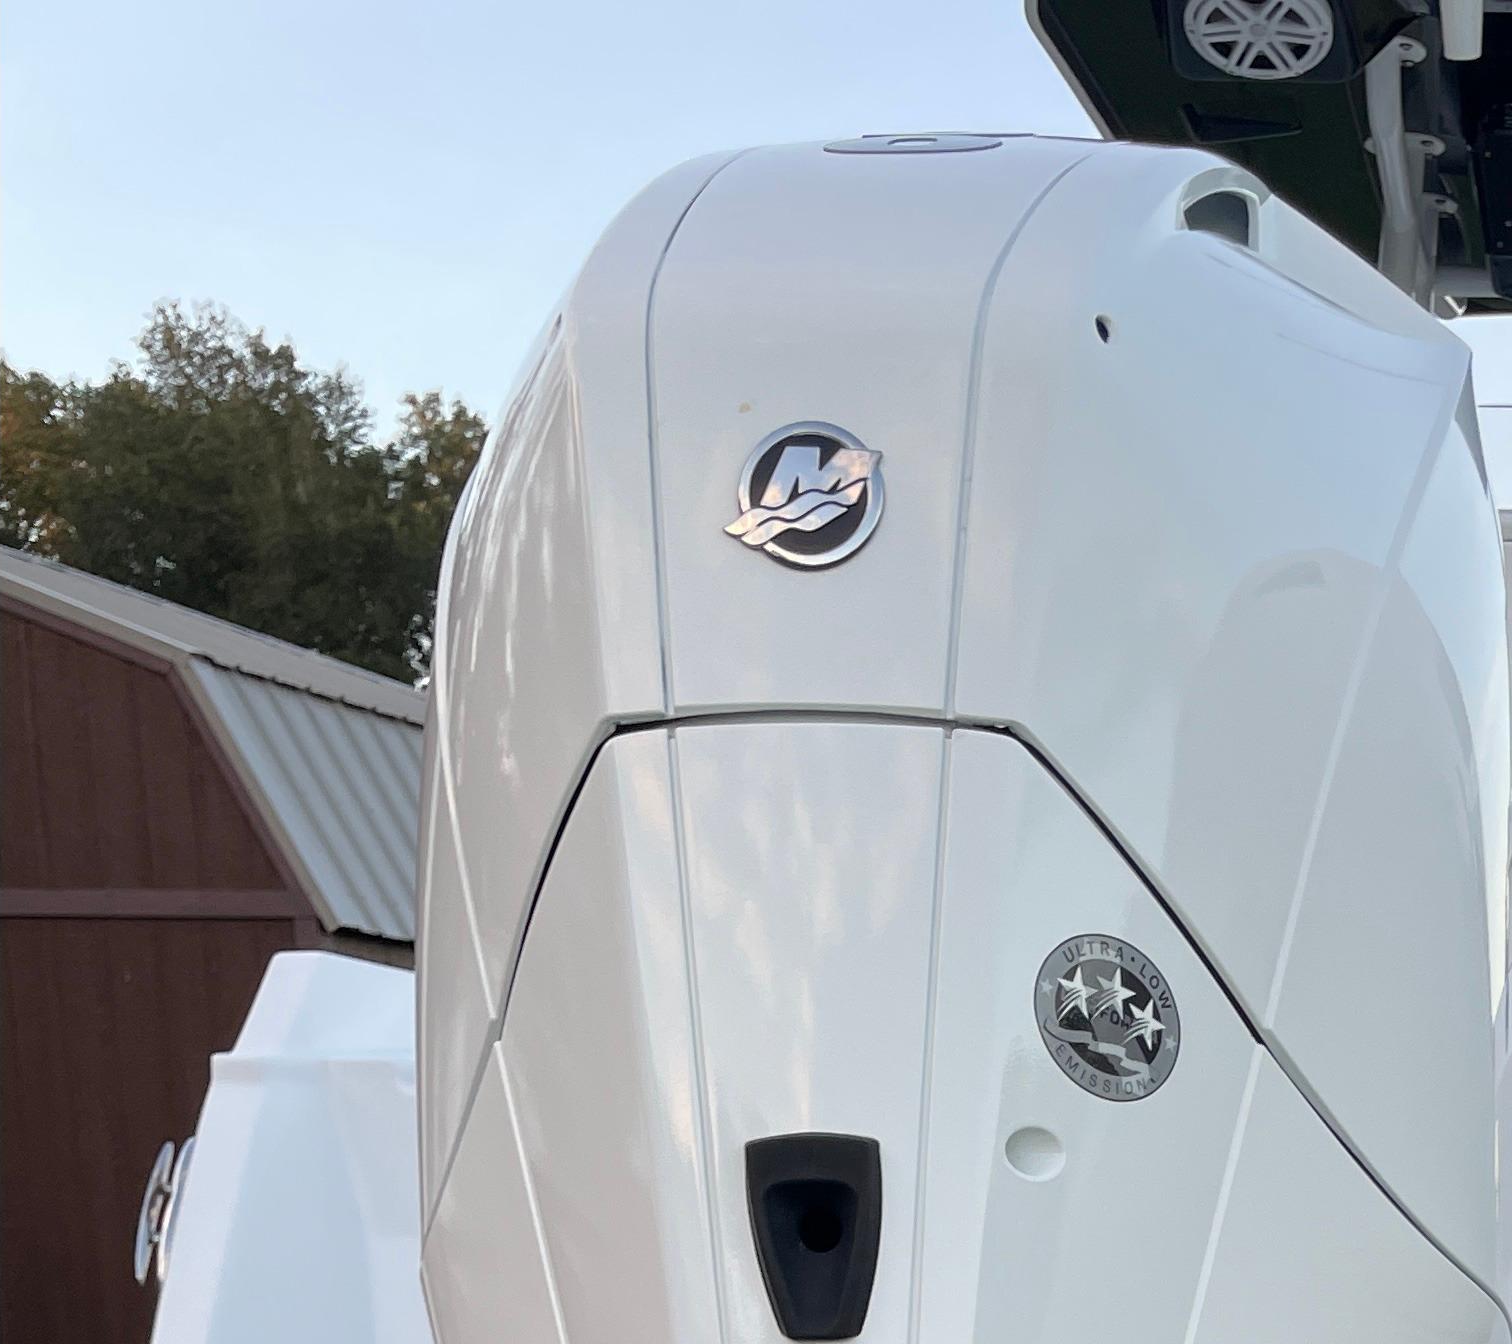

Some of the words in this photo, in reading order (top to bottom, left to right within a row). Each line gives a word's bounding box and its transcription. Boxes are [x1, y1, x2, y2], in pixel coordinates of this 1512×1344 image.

[1061, 940, 1124, 963] ULTRA
[1139, 963, 1173, 1010] LOW
[1055, 1043, 1147, 1096] EMISSION
